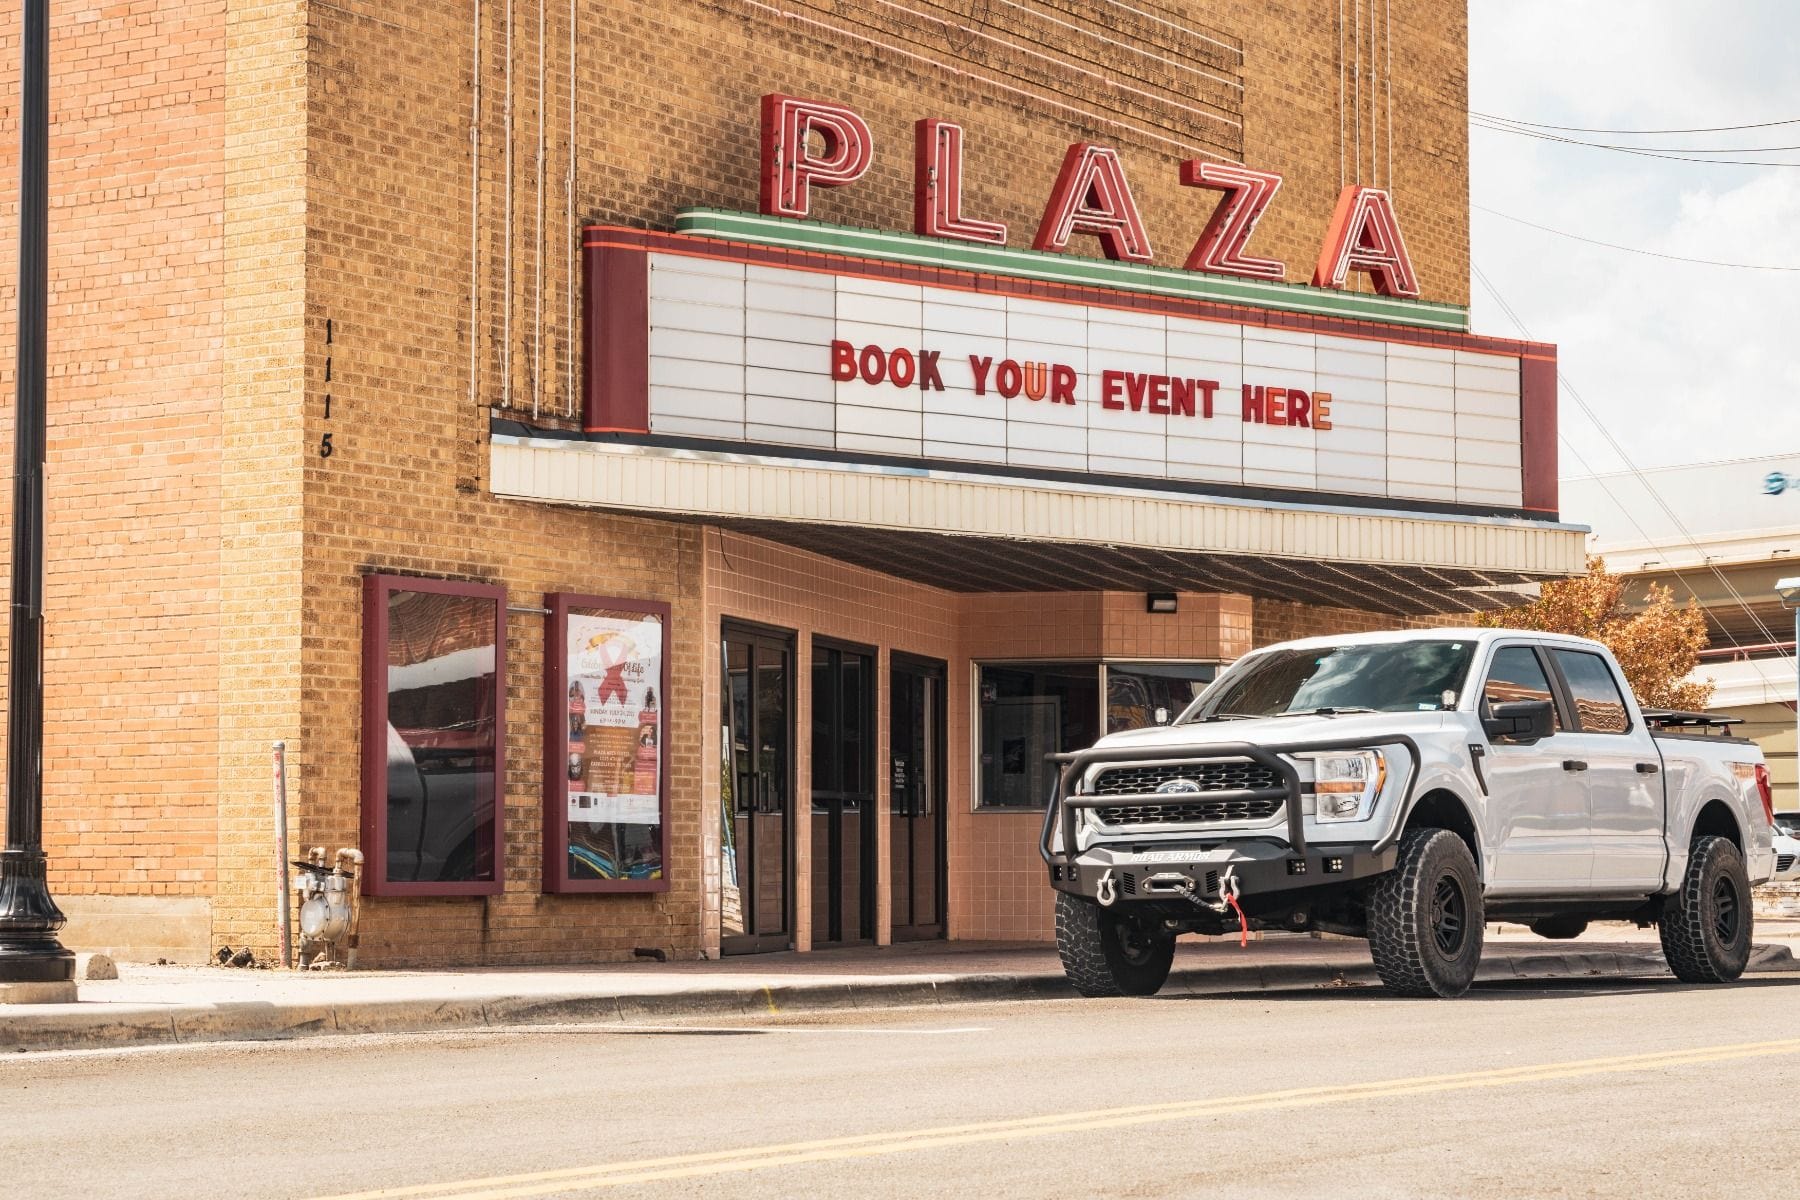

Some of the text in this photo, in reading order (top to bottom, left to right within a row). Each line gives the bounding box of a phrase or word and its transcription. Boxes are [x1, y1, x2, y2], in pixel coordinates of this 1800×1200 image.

[761, 94, 1421, 298] PLAZA
[320, 318, 333, 459] 1115
[832, 339, 1333, 431] BOOK YOUR EVENT HERE
